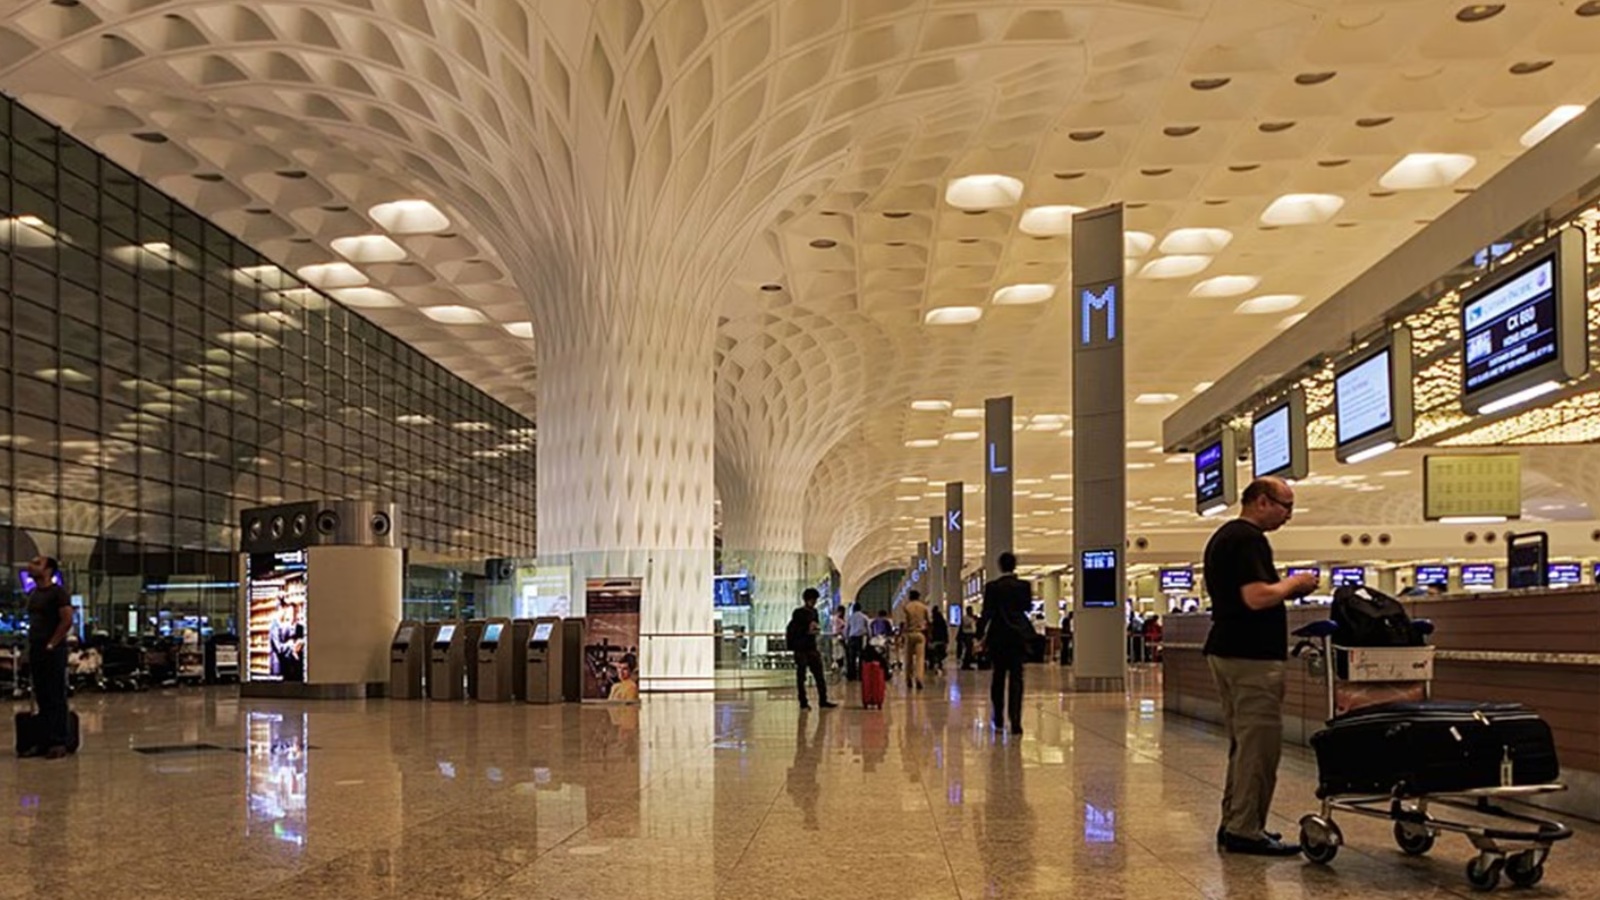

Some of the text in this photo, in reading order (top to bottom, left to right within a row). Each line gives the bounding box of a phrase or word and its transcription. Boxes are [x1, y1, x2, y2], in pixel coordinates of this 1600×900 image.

[1081, 285, 1116, 344] M
[990, 442, 1008, 474] L
[949, 510, 961, 532] K
[932, 539, 942, 554] J
[918, 559, 928, 571] H
